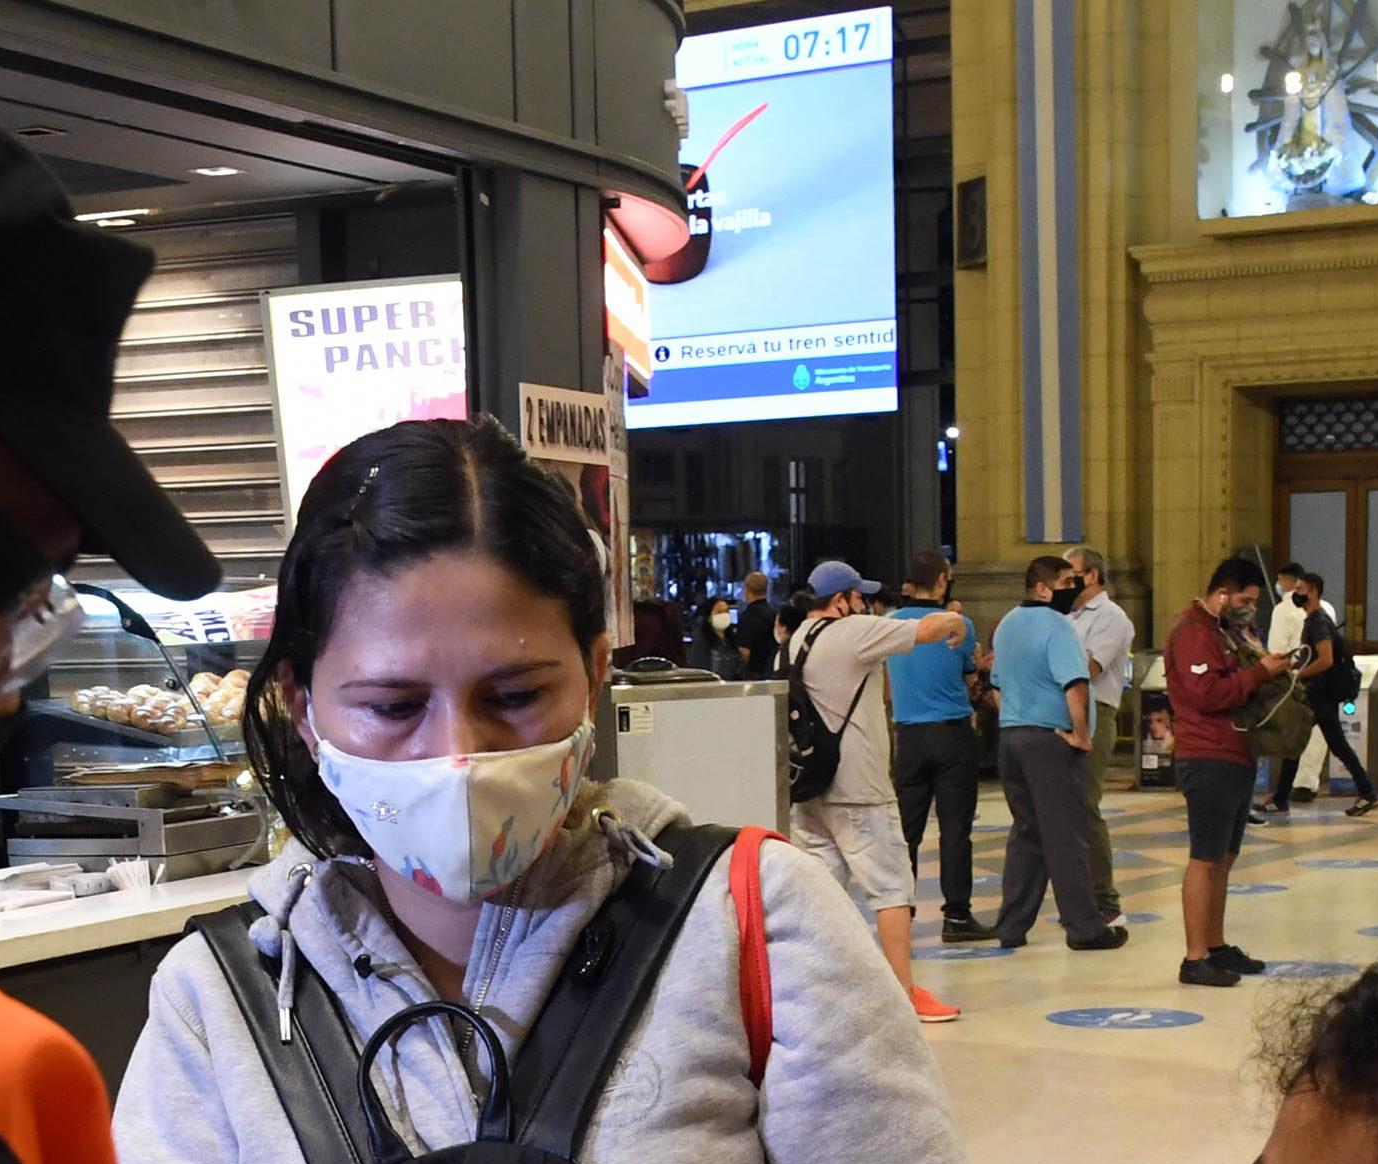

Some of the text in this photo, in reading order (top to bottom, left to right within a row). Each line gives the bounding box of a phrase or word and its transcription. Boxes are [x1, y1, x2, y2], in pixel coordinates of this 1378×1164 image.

[784, 23, 871, 61] 07:17
[689, 207, 772, 236] la vajilla
[288, 300, 436, 338] SUPER
[680, 327, 895, 360] Reservá tu tren sentid
[525, 396, 534, 443] 2
[537, 398, 607, 451] EMPANADAS
